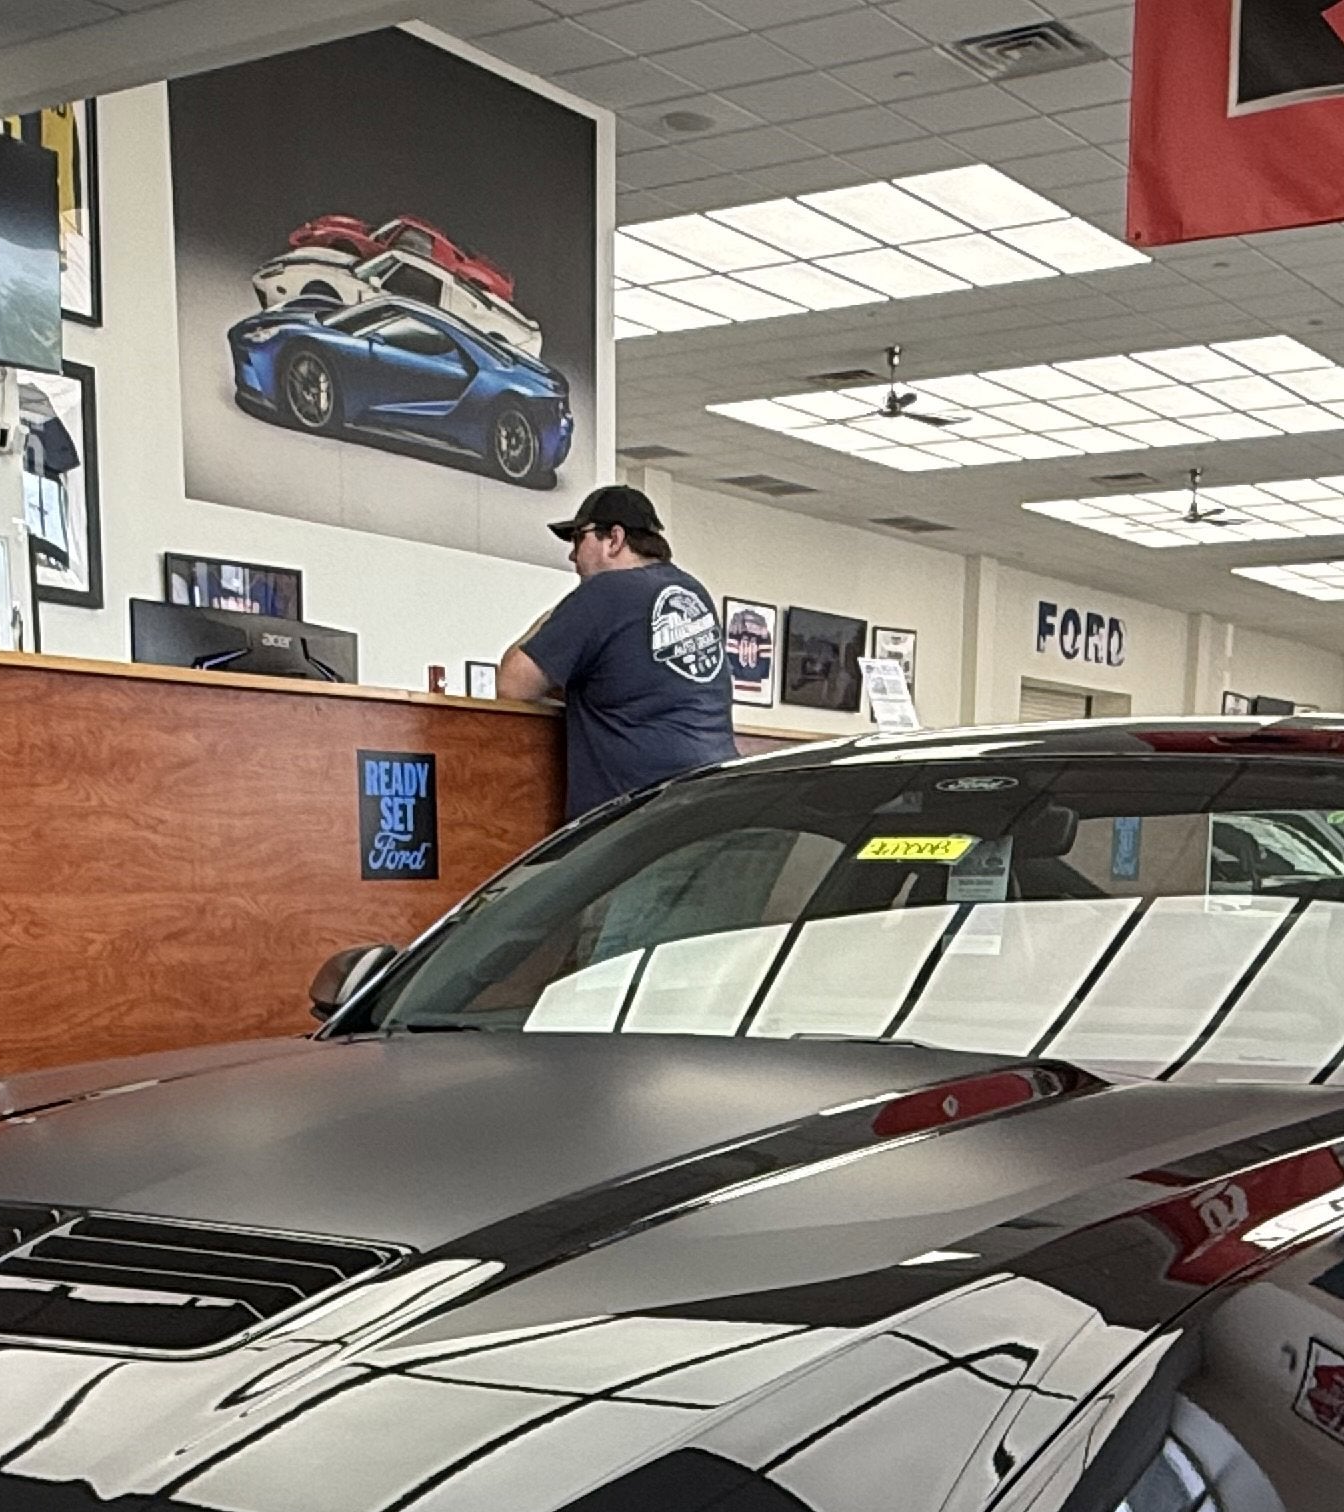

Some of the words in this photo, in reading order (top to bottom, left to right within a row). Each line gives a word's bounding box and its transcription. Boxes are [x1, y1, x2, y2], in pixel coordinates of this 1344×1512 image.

[262, 632, 293, 649] acer
[1036, 600, 1127, 667] FORD
[364, 760, 430, 798] READY
[380, 797, 416, 832] SET
[368, 831, 426, 870] Ford
